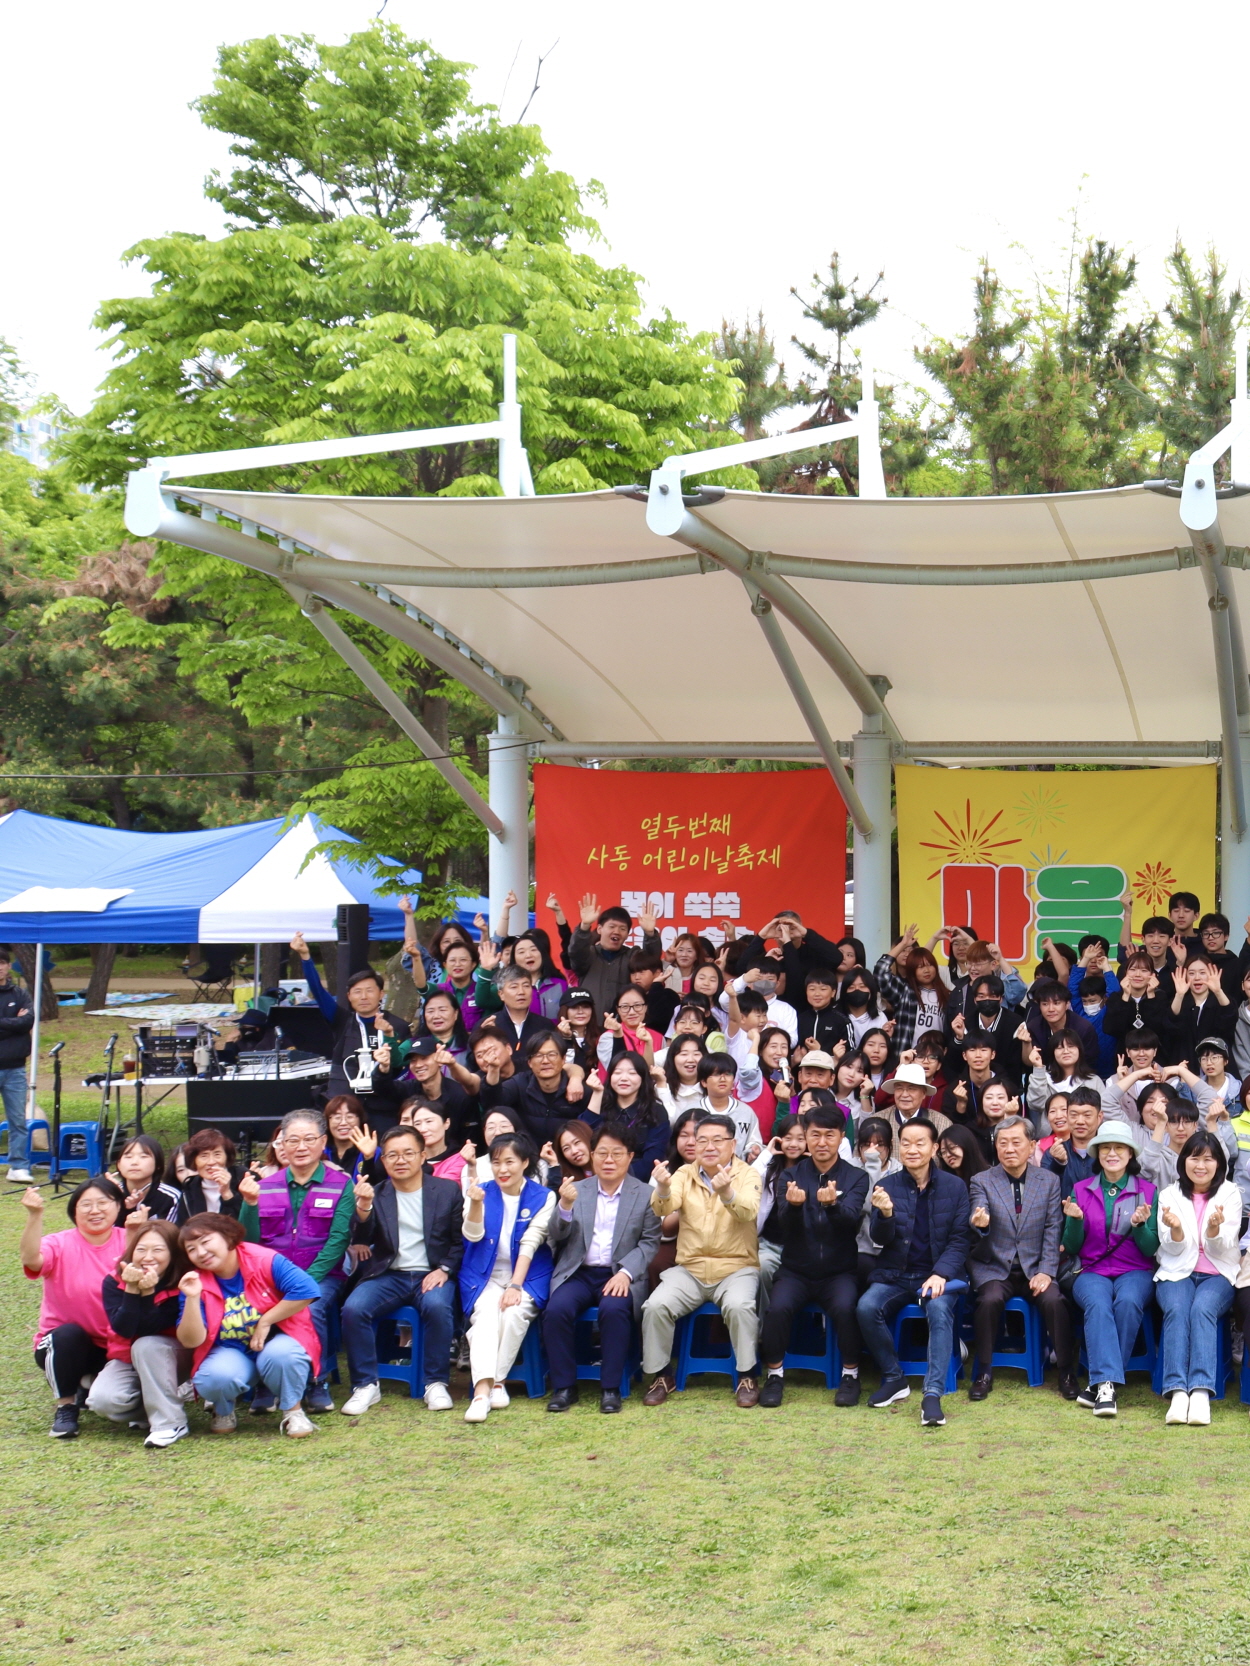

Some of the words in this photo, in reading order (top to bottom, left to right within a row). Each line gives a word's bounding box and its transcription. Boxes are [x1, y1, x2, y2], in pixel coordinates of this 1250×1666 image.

[640, 812, 731, 841] 열두번째
[587, 844, 632, 872] 사동
[642, 843, 781, 875] 어린이날축제
[684, 892, 741, 919] 쑥쑥
[941, 863, 1128, 962] 마을
[917, 1013, 934, 1028] 60
[738, 1121, 751, 1135] W
